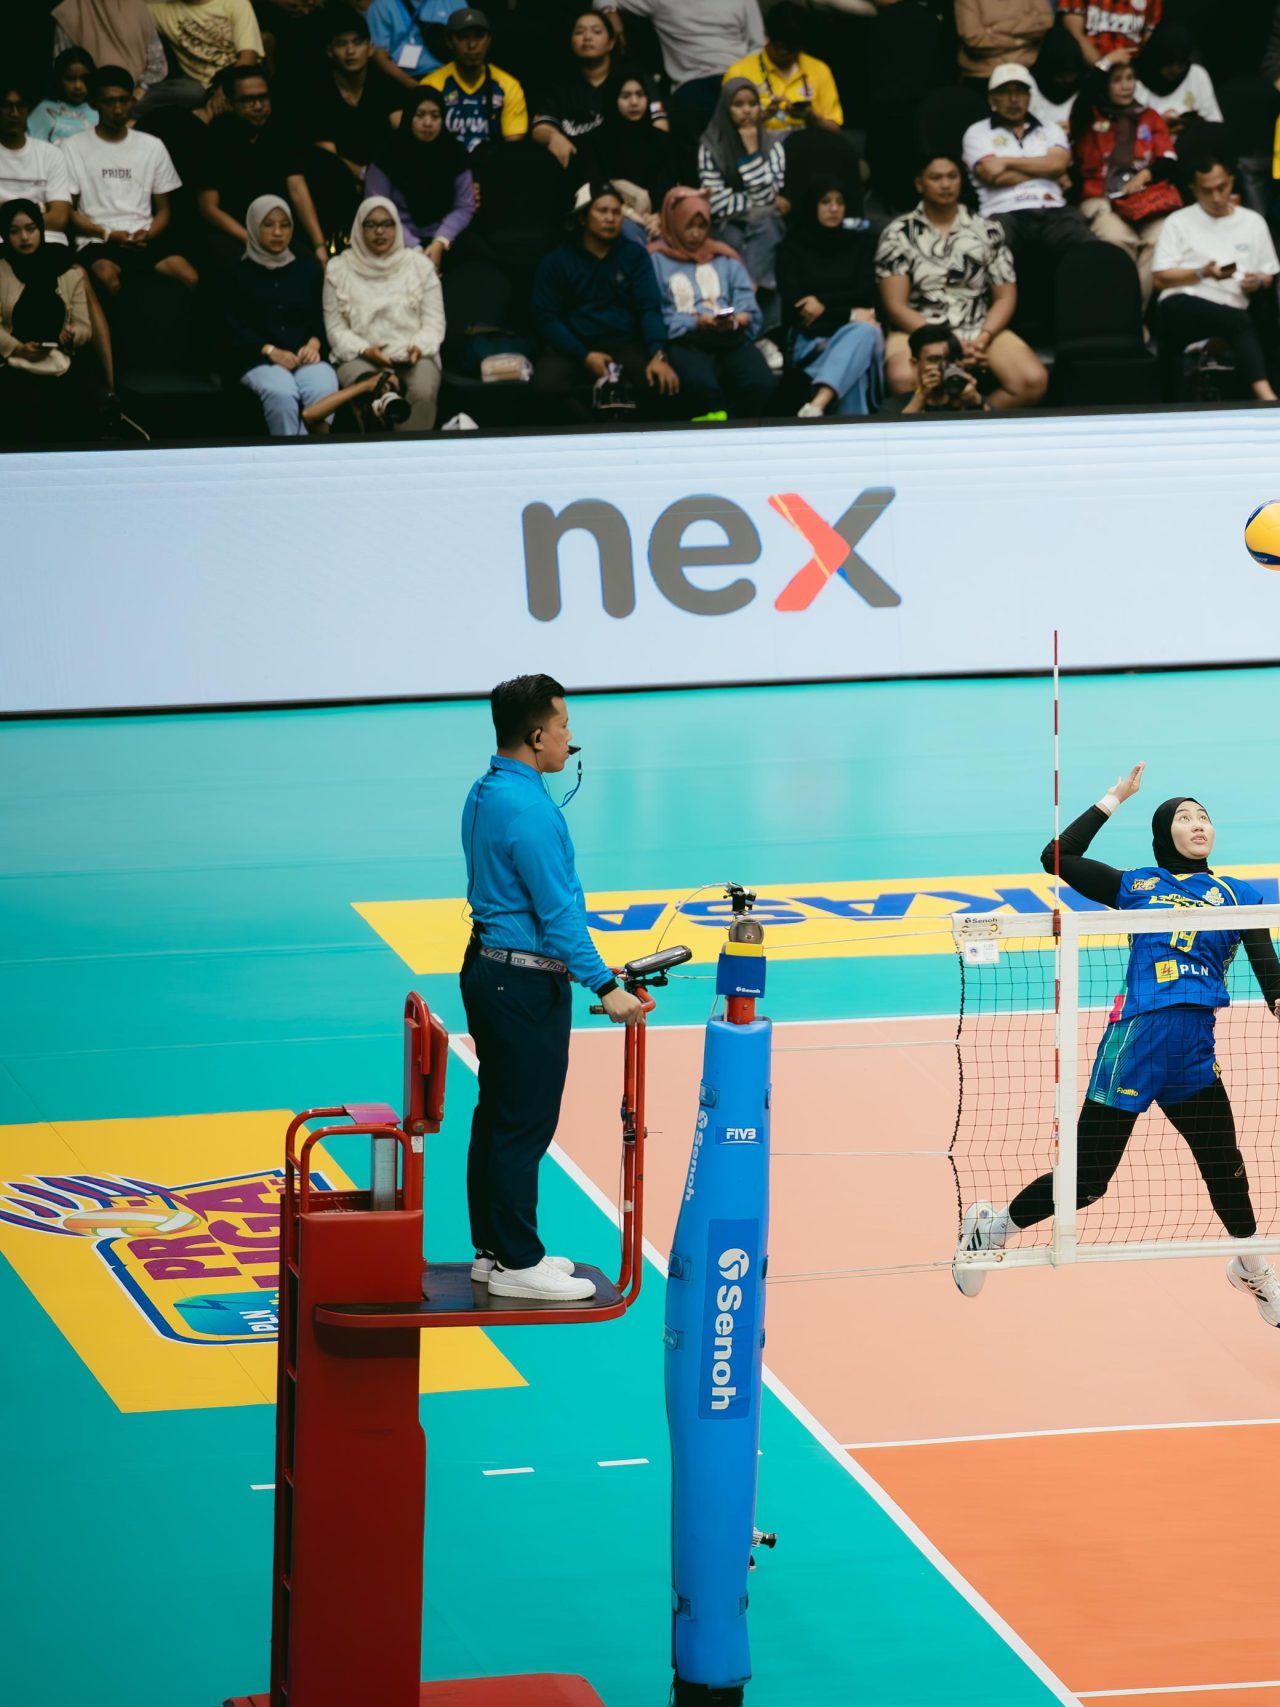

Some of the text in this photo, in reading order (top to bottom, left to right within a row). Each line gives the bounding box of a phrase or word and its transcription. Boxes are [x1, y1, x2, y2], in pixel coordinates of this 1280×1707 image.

[521, 486, 902, 622] nex
[1180, 964, 1209, 977] PLN
[684, 1128, 704, 1201] Senoh
[726, 1127, 757, 1140] FIVB
[711, 1284, 743, 1411] Senoh
